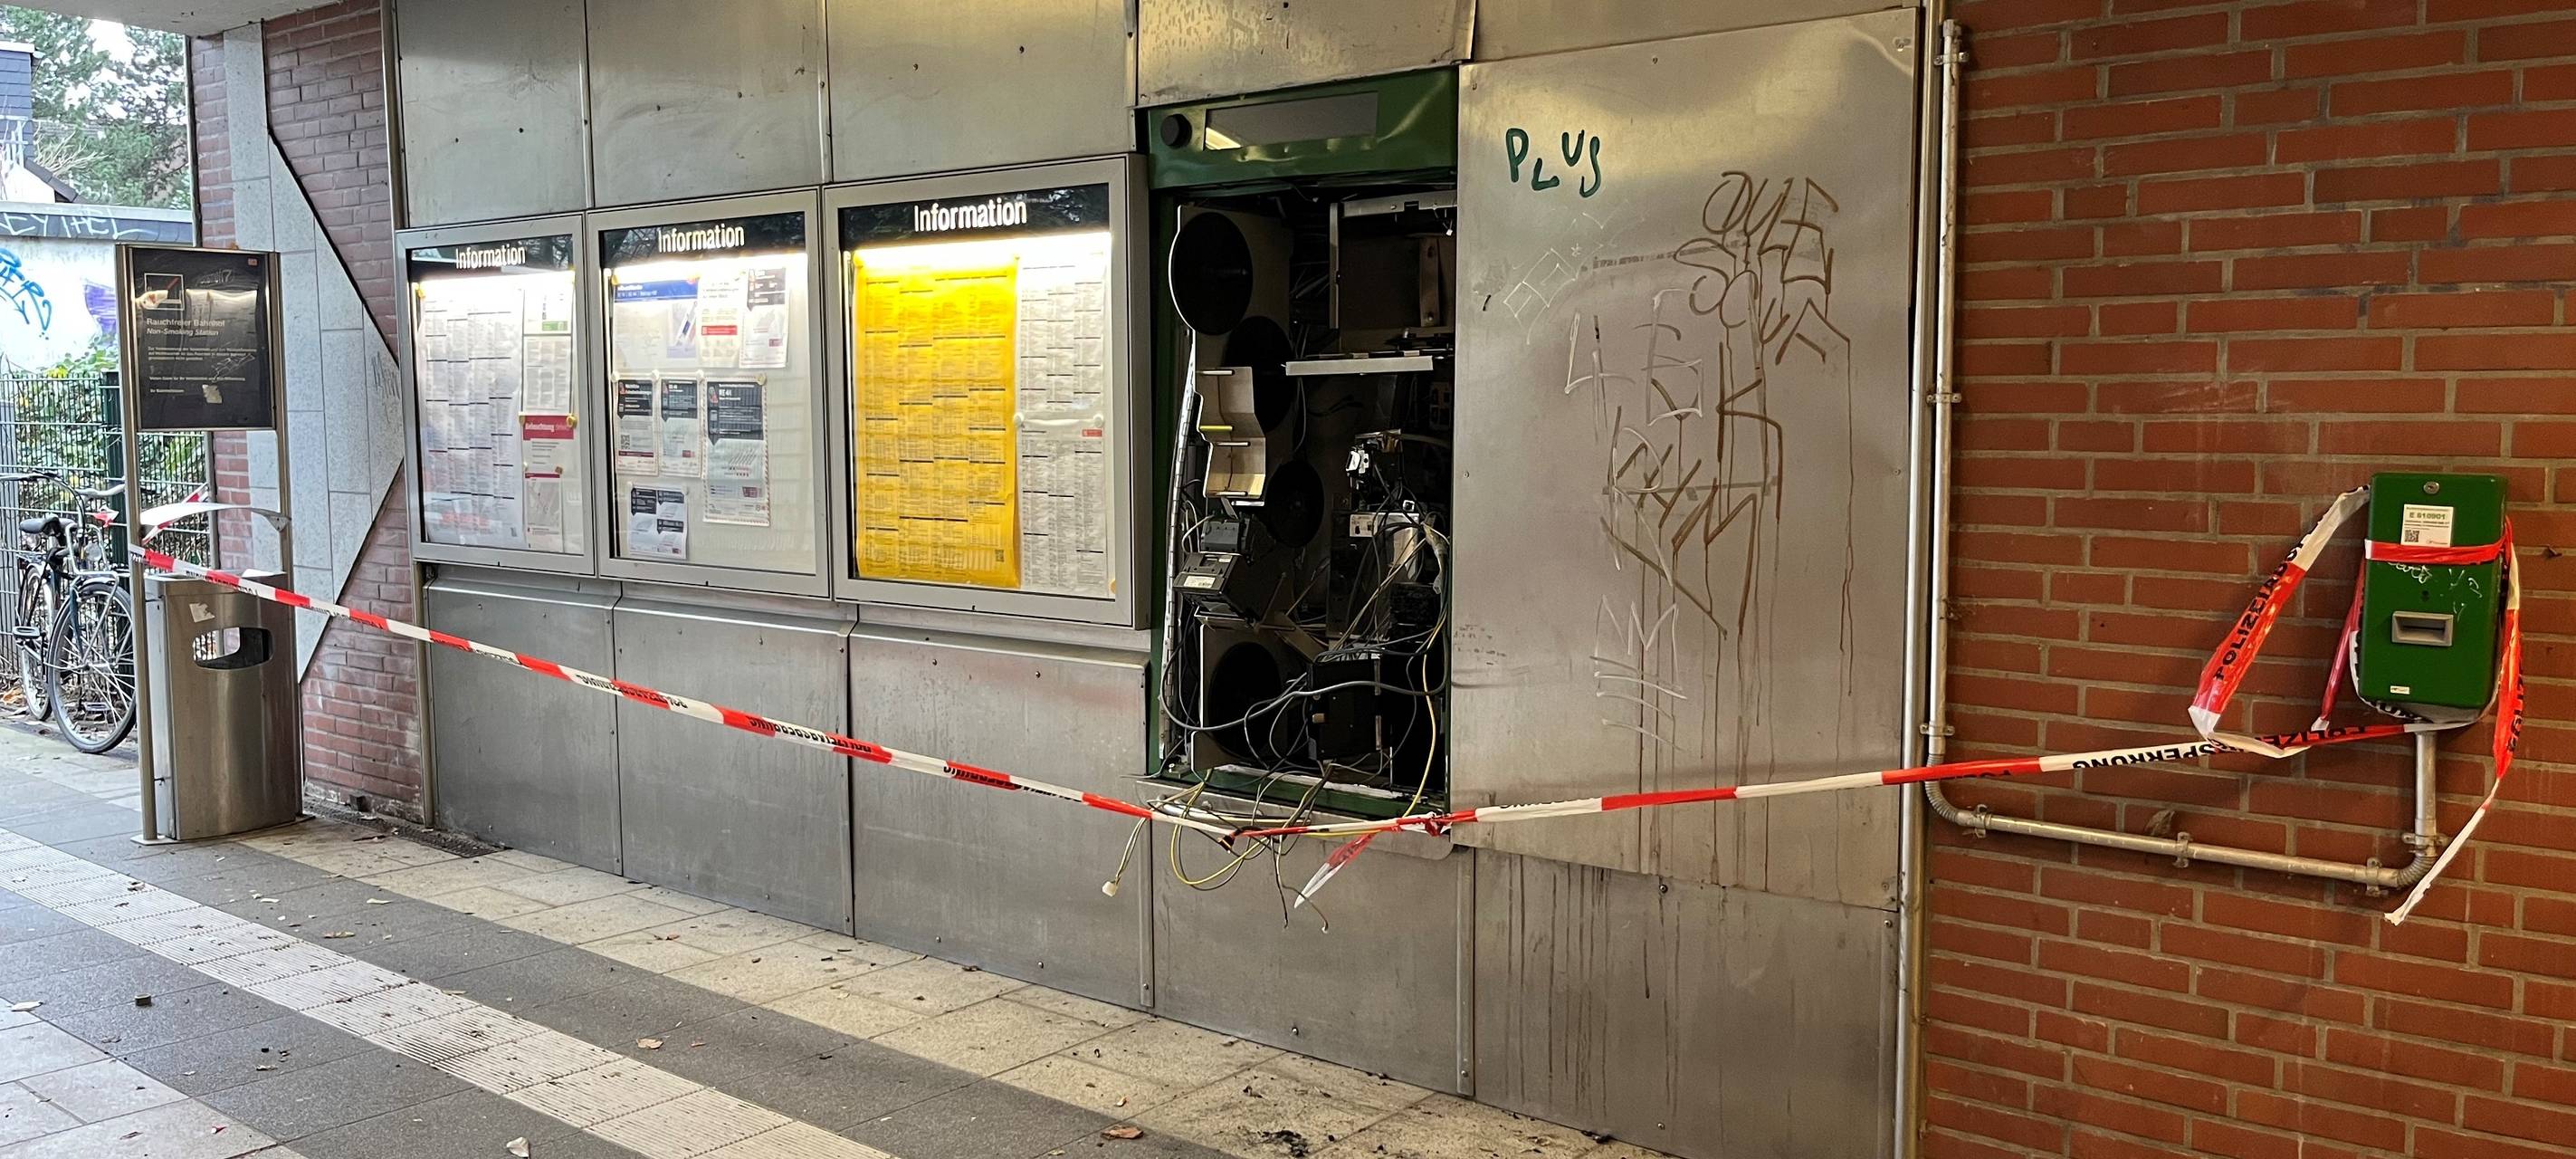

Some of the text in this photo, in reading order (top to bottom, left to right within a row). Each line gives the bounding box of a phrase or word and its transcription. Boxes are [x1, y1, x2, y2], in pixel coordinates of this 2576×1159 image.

[1505, 127, 1602, 198] PLUS
[914, 197, 1027, 233] Information
[657, 224, 745, 254] Information
[455, 244, 527, 270] Information
[146, 318, 225, 328] Rauchfreier Bahnhof
[146, 328, 194, 337] Non-Smoking
